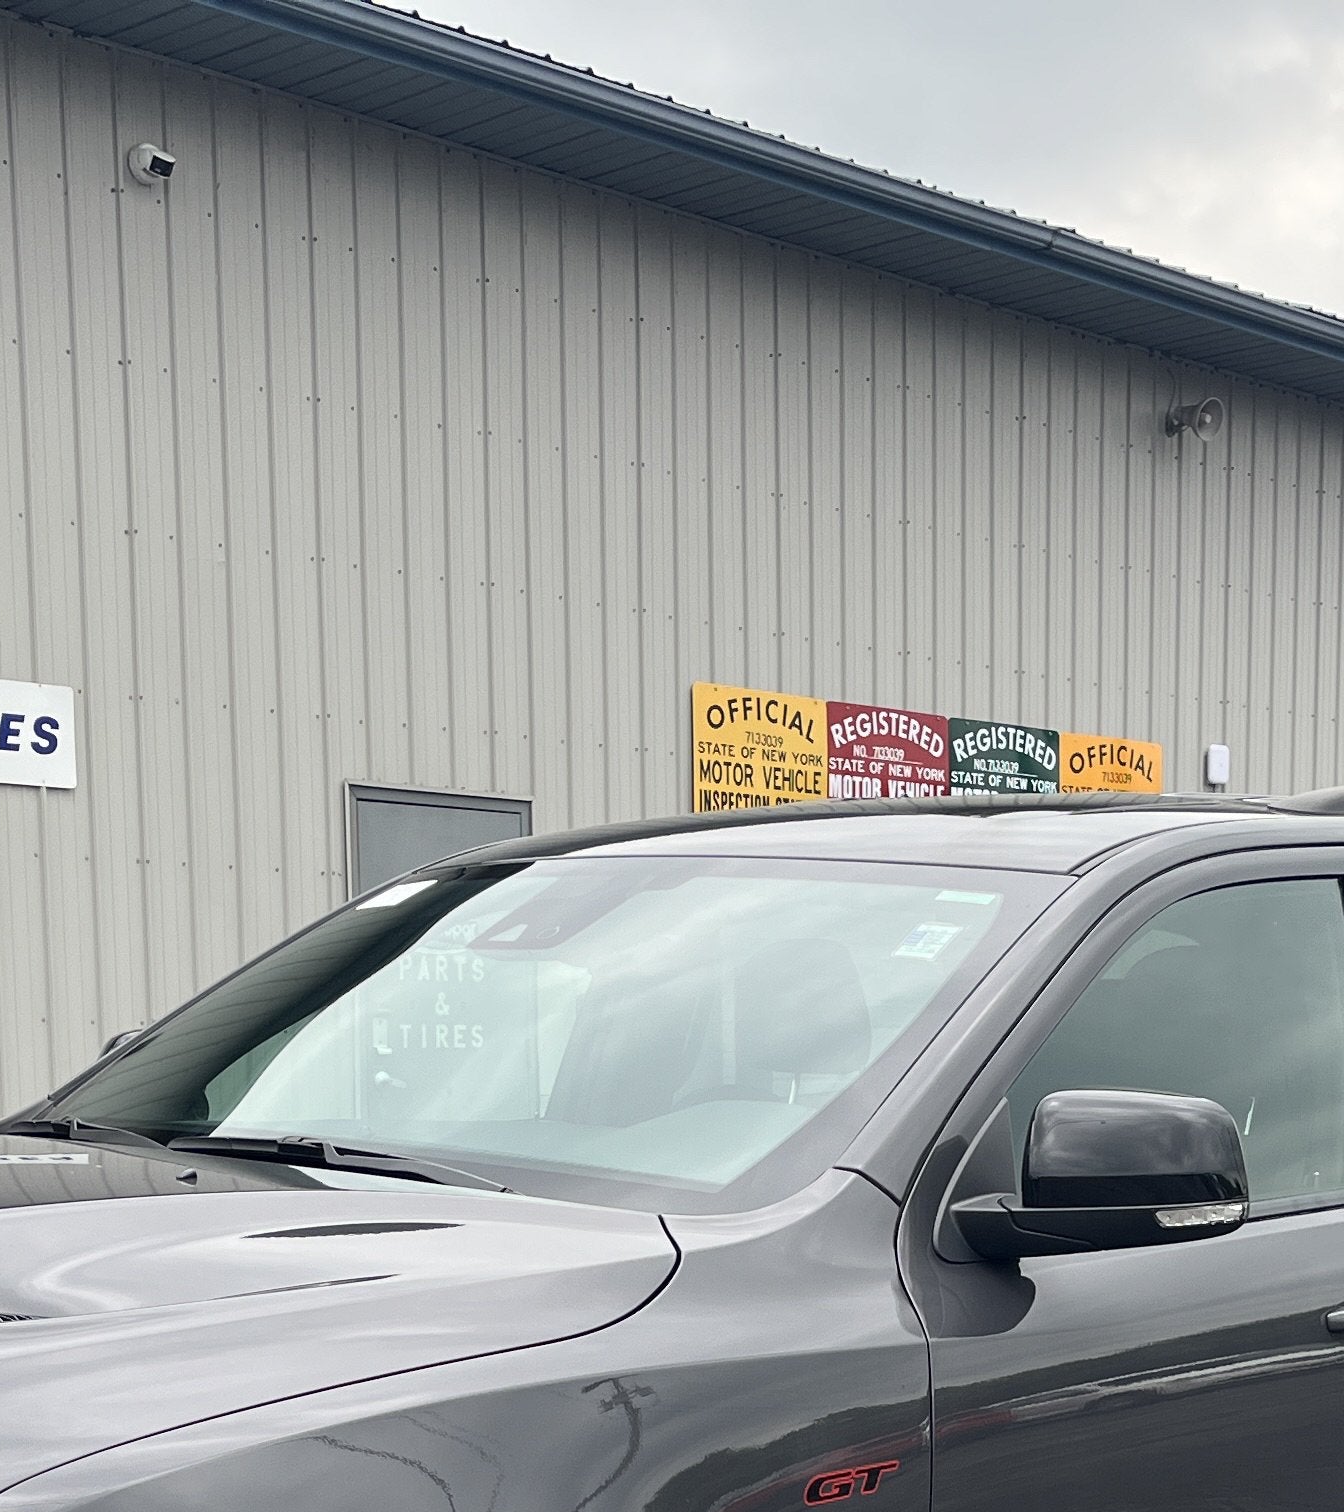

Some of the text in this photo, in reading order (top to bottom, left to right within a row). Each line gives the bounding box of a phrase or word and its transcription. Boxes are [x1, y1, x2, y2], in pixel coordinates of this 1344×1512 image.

[706, 697, 814, 744] OFFICIAL
[745, 731, 784, 748] 7133039
[830, 711, 944, 758] REGISTERED
[698, 741, 823, 767] STATE OF NEW YORK
[952, 726, 1056, 771] REGISTERED
[699, 758, 821, 795] MOTOR VEHICLE
[829, 757, 945, 782] STATE OF NEW YORK
[1069, 744, 1153, 783] OFFICIAL
[829, 773, 882, 799] MOTOR
[951, 770, 1058, 794] STATE OF NEW YORK
[399, 955, 484, 982] PARTS
[435, 992, 450, 1016] &
[399, 1024, 484, 1049] TIRES
[804, 1460, 900, 1506] GT
